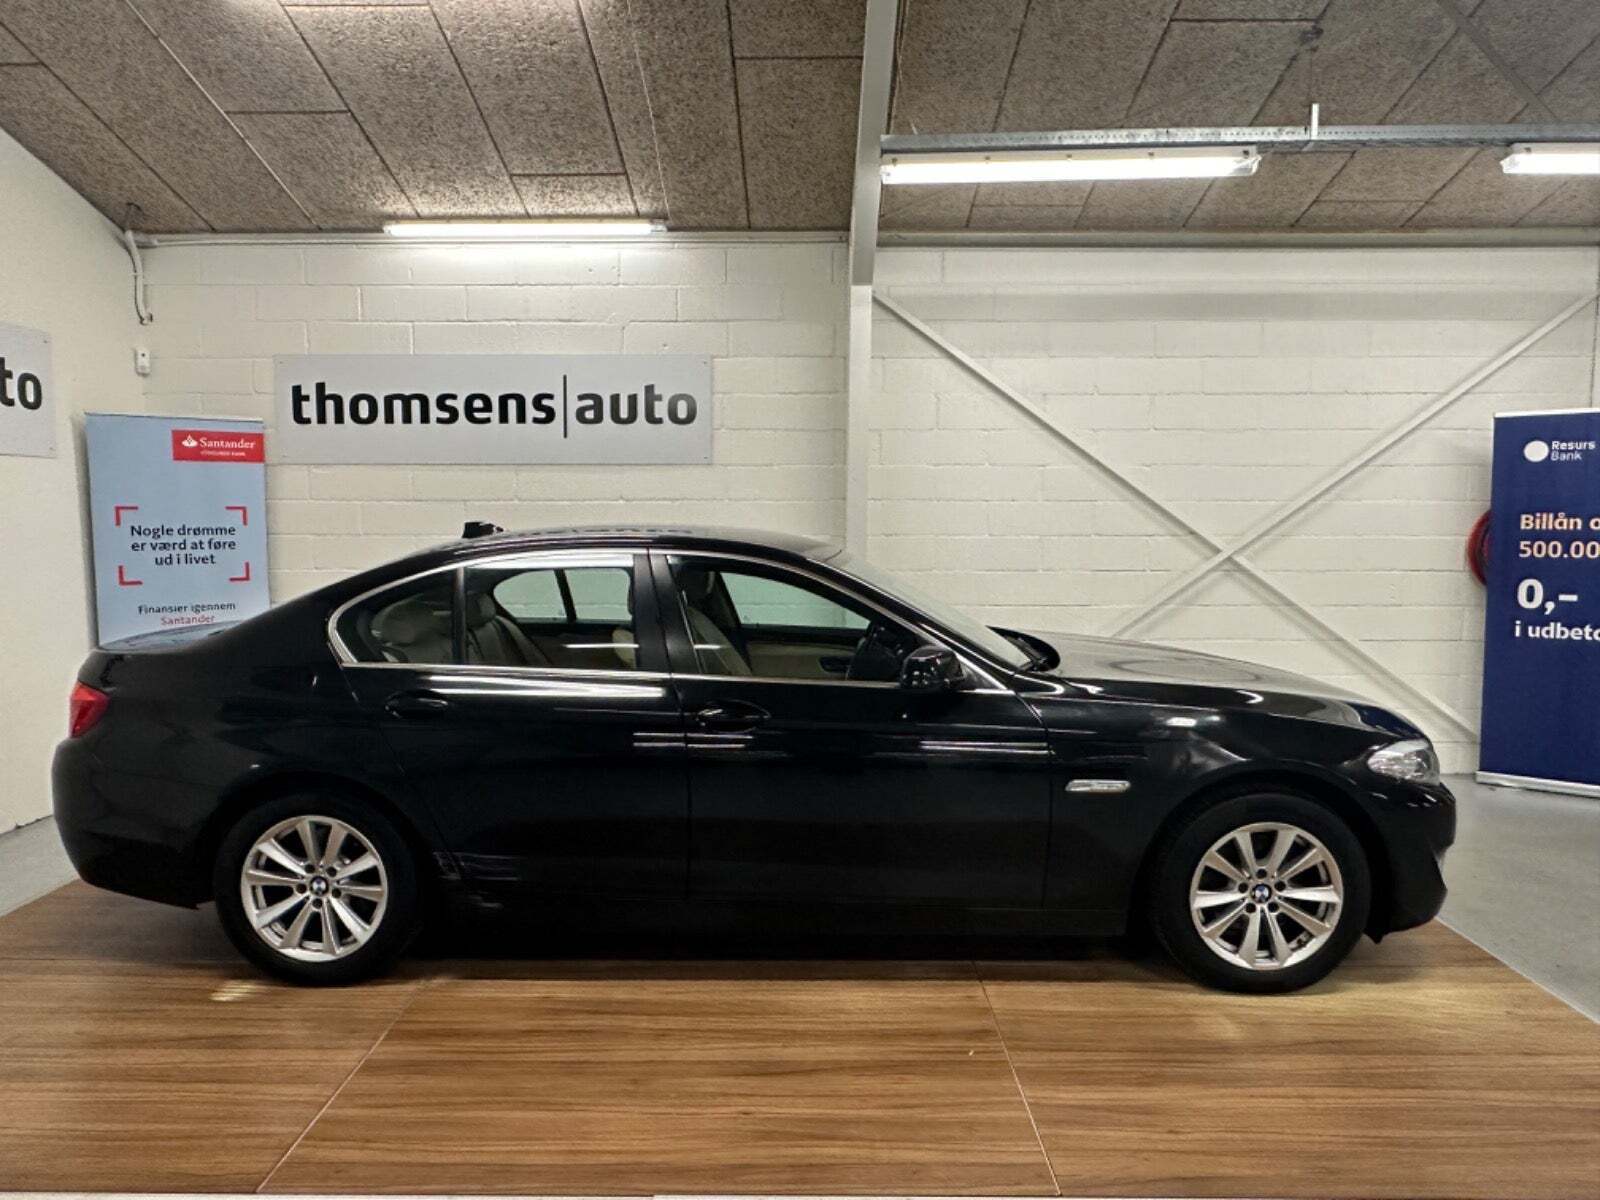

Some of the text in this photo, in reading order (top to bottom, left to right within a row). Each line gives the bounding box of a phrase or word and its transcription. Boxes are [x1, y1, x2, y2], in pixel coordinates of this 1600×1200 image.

[291, 382, 698, 425] thomsens auto
[200, 436, 256, 450] Santander
[1551, 440, 1596, 450] Resurs
[1551, 450, 1582, 461] Bank
[1520, 512, 1582, 530] Billån
[130, 523, 237, 539] Nogle drømme
[131, 537, 237, 551] er værd at føre
[1518, 540, 1600, 558] 500.00
[154, 552, 217, 566] ud i livet
[138, 603, 236, 614] Finansier igennem
[161, 615, 215, 625] Santander
[1514, 620, 1522, 638] i
